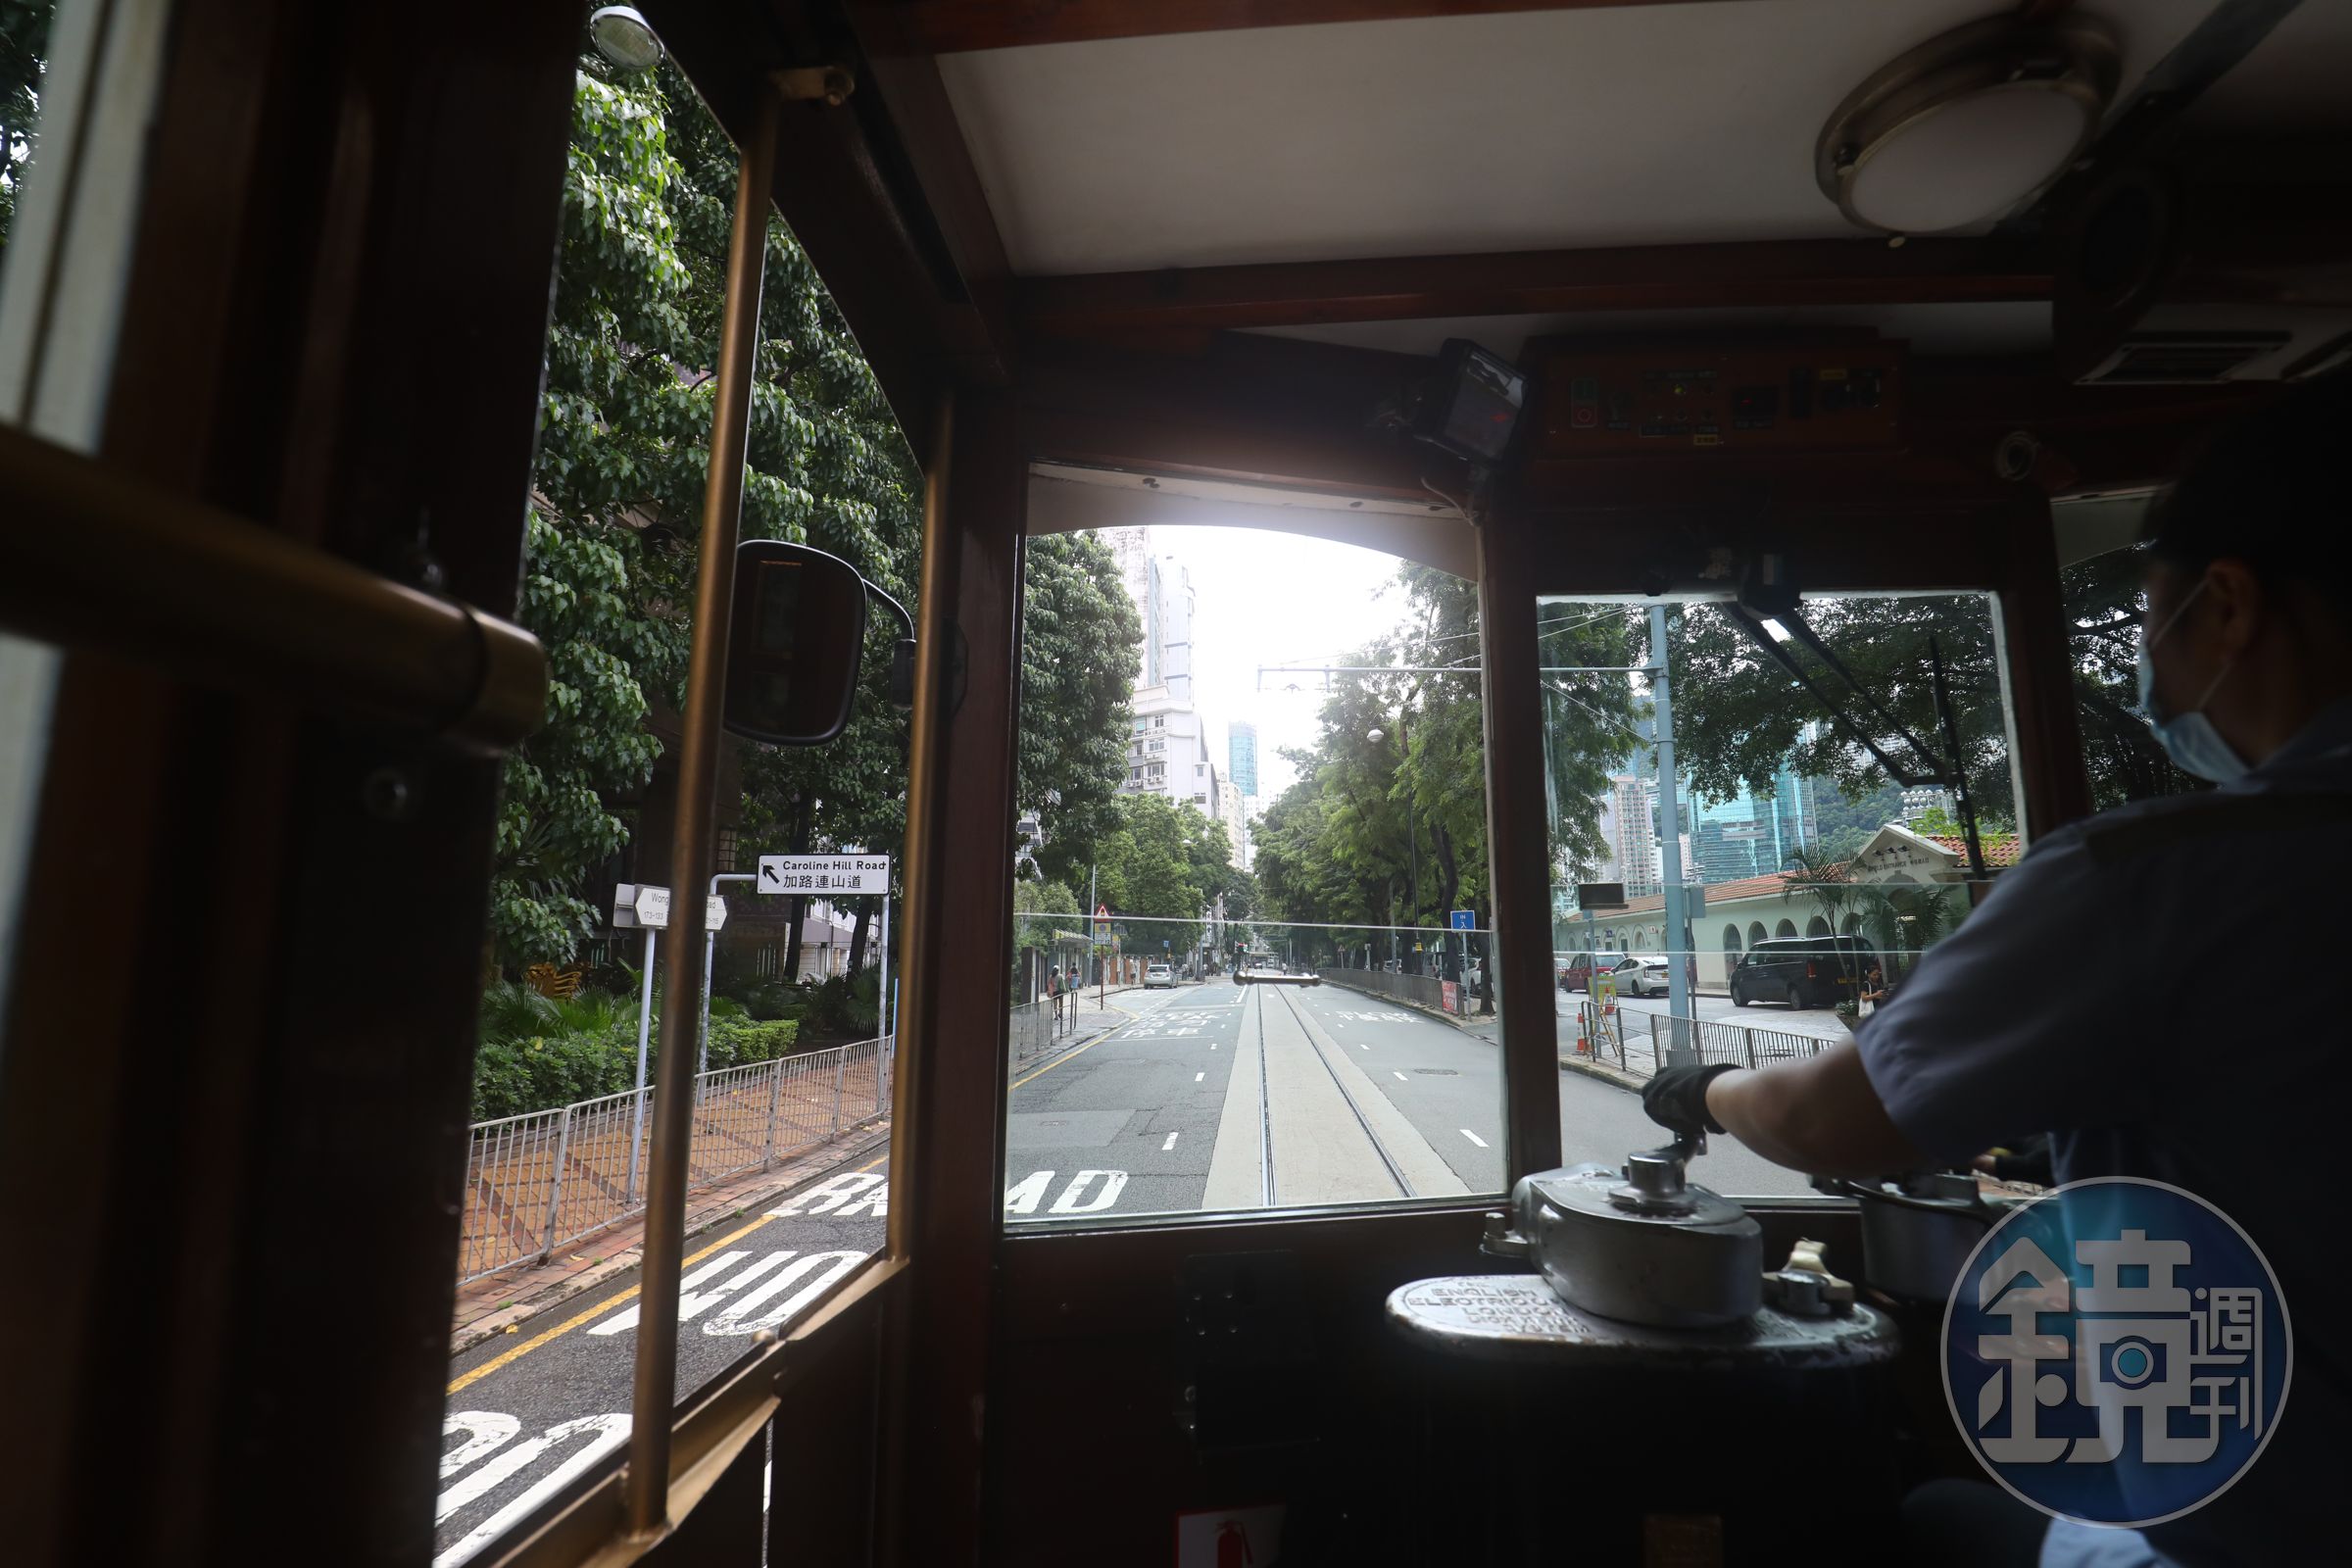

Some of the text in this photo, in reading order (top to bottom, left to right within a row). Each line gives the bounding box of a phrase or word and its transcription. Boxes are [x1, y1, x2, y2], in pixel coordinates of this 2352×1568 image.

[782, 860, 887, 870] Caroline Hill Road
[783, 874, 862, 889] 加路連山道
[651, 892, 669, 906] Wong
[1431, 1287, 1538, 1298] ENGLISH
